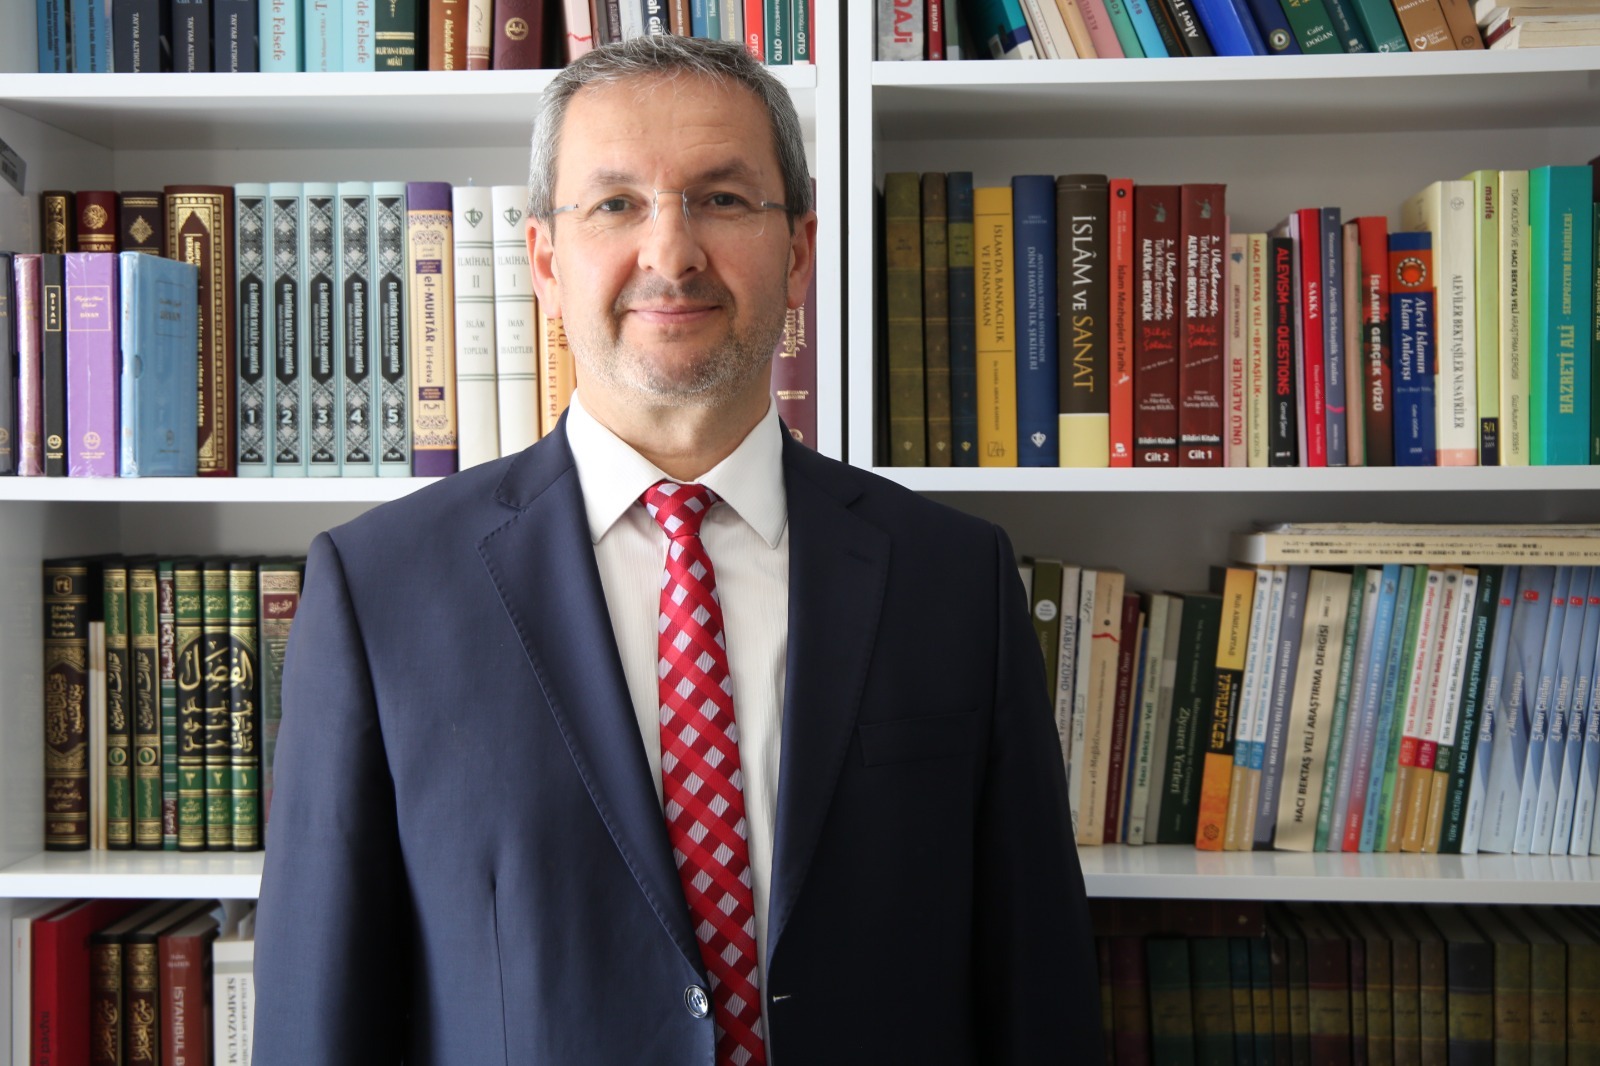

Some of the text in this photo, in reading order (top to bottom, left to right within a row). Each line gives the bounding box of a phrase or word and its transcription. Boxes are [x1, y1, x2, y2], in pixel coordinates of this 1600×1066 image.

[272, 17, 285, 61] Felsefe
[1176, 8, 1200, 40] Alevi
[1305, 30, 1334, 48] DOĞAN
[1306, 24, 1324, 36] Cafer
[356, 20, 369, 63] Felsefe
[773, 38, 783, 62] OTTO
[797, 32, 806, 54] OTTO
[1484, 185, 1494, 220] marife
[1510, 188, 1519, 206] TÜRK
[1510, 207, 1519, 237] KÜLTÜRÜ
[1027, 246, 1037, 268] DİNİ
[1253, 239, 1261, 263] HACI
[1510, 238, 1519, 248] VE
[1510, 249, 1518, 268] HACI
[458, 256, 491, 268] İLMİHAL
[1185, 235, 1198, 318] ALEVİLİK BEKTAŞİLİK
[1199, 235, 1210, 317] Türk Kültür Evreninde
[1276, 247, 1290, 303] ALEVISM
[981, 245, 992, 327] VE FİNANSMAN
[994, 224, 1005, 343] İSLAM'DA BANKACILIK
[1027, 270, 1037, 309] HAYATIN
[1140, 238, 1153, 321] ALEVİLİK BEKTAŞİLİK
[1154, 238, 1165, 321] Türk Kültür Evreninde
[1252, 266, 1261, 302] BEKTAŞ
[1510, 269, 1519, 297] BEKTAŞ
[1562, 263, 1572, 315] SEMPOZYUM
[424, 275, 438, 342] el-MUHTÂR
[1071, 214, 1098, 393] İSLÂM VE SANAT
[1253, 305, 1261, 326] VELİ
[1308, 281, 1318, 319] SAKKA
[1415, 297, 1427, 328] Alevi
[1511, 298, 1520, 314] VELİ
[1115, 264, 1128, 373] İslam Mezhepleri Tarihi
[464, 346, 488, 356] TOPLUM
[1027, 327, 1039, 370] ŞEKİLLERİ
[1369, 273, 1383, 412] İSLAMIN GERÇEK YÜZÜ
[1450, 273, 1467, 429] ALEVİLER BEKTAŞİLER NUSAYRİLER
[1556, 324, 1574, 348] ALİ
[1276, 325, 1289, 395] QUESTIONS
[1399, 332, 1414, 381] Anlayışı
[1556, 352, 1574, 414] HAZRETİ
[248, 409, 255, 423] 1
[281, 409, 293, 424] 2
[317, 409, 328, 424] 3
[351, 409, 363, 423] 4
[387, 409, 399, 423] 5
[1231, 358, 1243, 446] ÜNLÜ ALEVİLER
[1138, 437, 1176, 445] Bildiri Kitabı
[1181, 434, 1220, 442] Bildiri Kitabı
[1279, 420, 1288, 438] Şener
[1144, 452, 1169, 462] Cilt 2
[1187, 449, 1212, 460] Cilt 1
[1314, 624, 1330, 666] DERGİSİ
[1475, 615, 1487, 649] DERGİSİ
[1467, 650, 1482, 699] ARAŞTIRMA
[1269, 640, 1292, 766] HACI BEKTAŞ VELİ ARAŞTIRMA DERGİSİ
[1306, 668, 1323, 730] ARAŞTIRMA
[1481, 676, 1498, 742] 6. Alevi Çalıştayı
[1533, 675, 1550, 741] 5. Alevi Çalıştayı
[1551, 675, 1568, 742] 4. Alevi Çalıştayı
[1574, 675, 1586, 711] Çalıştayı
[1145, 702, 1153, 717] Veli
[1210, 673, 1232, 749] YAHUDİLER
[1465, 700, 1475, 719] VELİ
[1507, 708, 1517, 729] Alevi
[1570, 711, 1582, 733] Alevi
[1589, 711, 1600, 733] Alevi
[1170, 706, 1191, 794] Ziyaret Yerleri
[1303, 732, 1314, 754] VELİ
[1460, 719, 1473, 751] BEKTAŞ
[1298, 757, 1313, 795] BEKTAŞ
[1458, 752, 1467, 774] HACI
[1294, 797, 1305, 823] HACI
[1450, 789, 1462, 821] KÜLTÜRÜ
[1448, 823, 1458, 842] TÜRK
[173, 986, 186, 1053] İSTANBUL
[227, 977, 238, 1064] SEMPOZYUM
